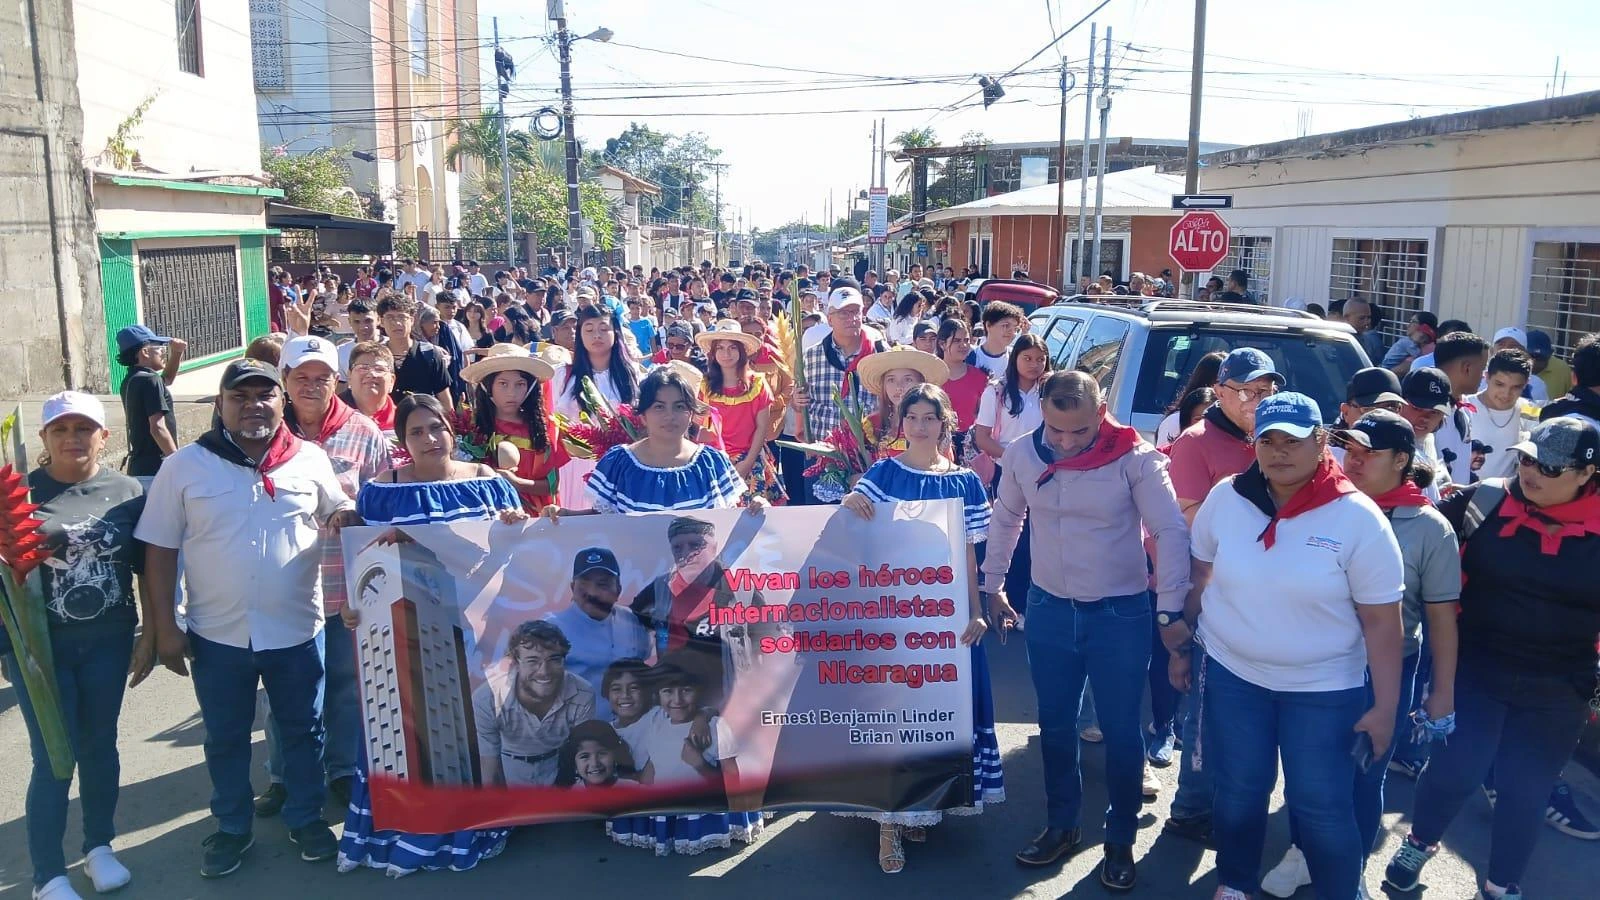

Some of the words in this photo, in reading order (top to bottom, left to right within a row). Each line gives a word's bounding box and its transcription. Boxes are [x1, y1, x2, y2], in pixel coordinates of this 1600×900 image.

[1174, 230, 1224, 252] ALTO
[1586, 448, 1594, 459] 8
[723, 569, 800, 591] Vivan
[809, 567, 850, 588] los
[859, 565, 954, 587] héroes
[709, 595, 955, 625] internacionalistas
[760, 630, 897, 653] solidarios
[905, 631, 957, 649] con
[818, 661, 958, 688] Nicaragua
[761, 711, 815, 725] Ernest
[820, 710, 896, 726] Benjamin
[902, 709, 955, 724] Linder
[850, 730, 893, 744] Brian
[899, 729, 955, 743] Wilson
